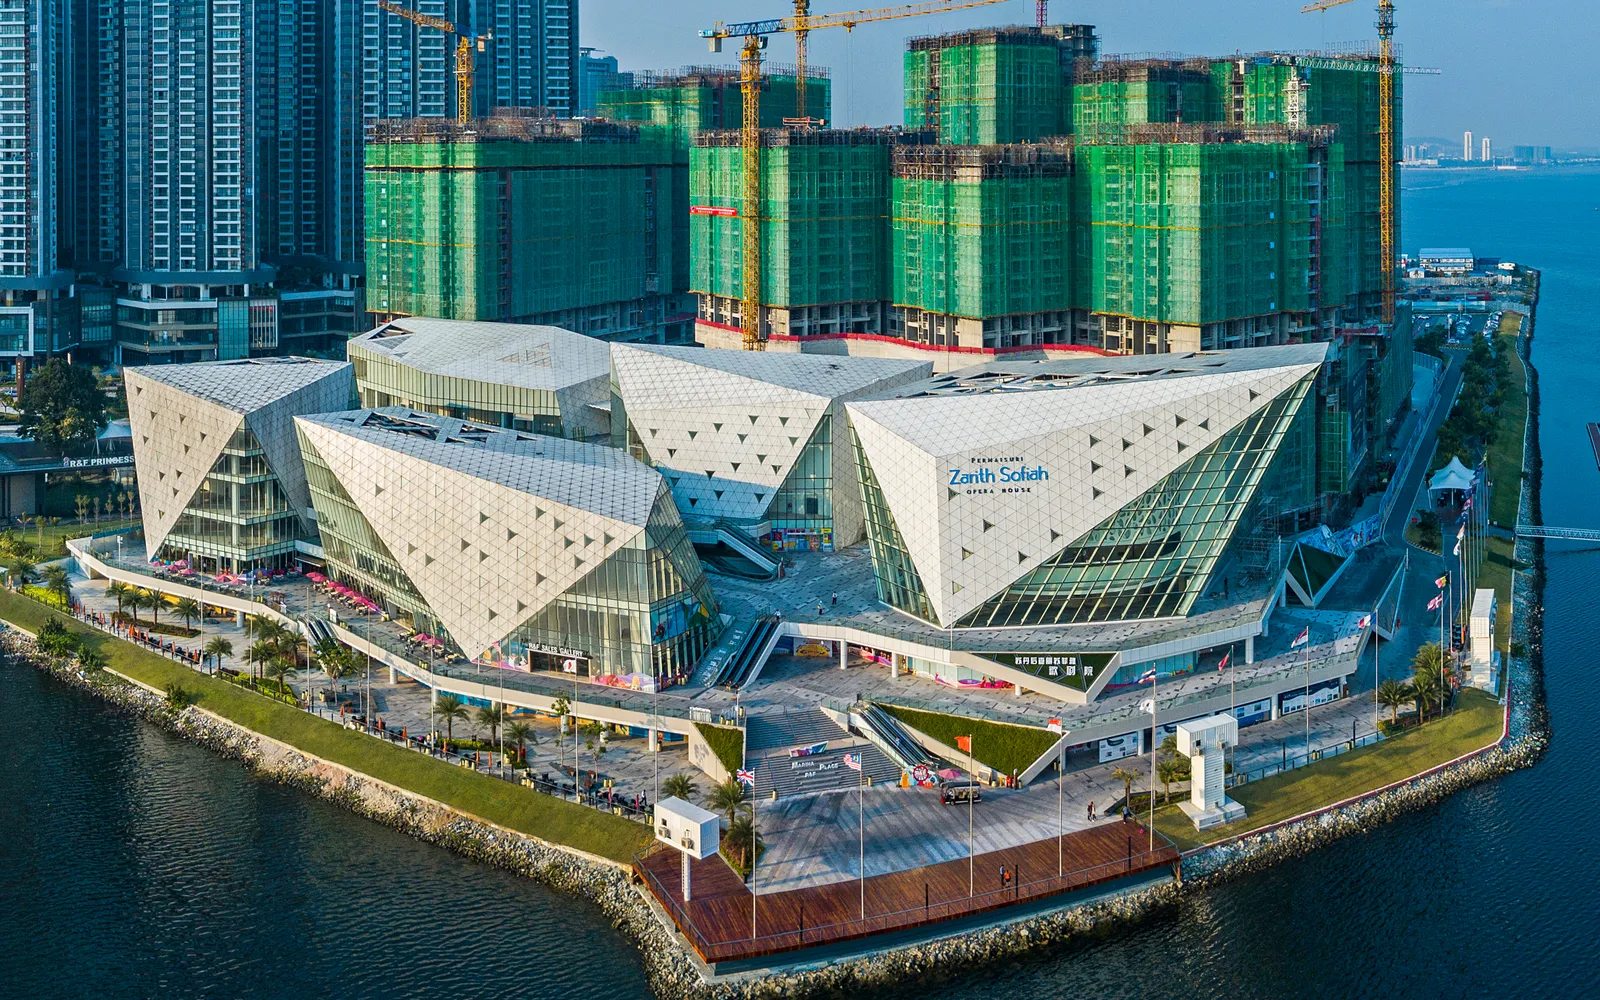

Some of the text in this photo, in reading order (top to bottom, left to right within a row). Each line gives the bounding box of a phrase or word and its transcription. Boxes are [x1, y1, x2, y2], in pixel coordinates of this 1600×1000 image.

[70, 455, 135, 467] R&F PRINCESS
[949, 465, 1049, 485] Zarith Sofiah
[541, 645, 559, 654] SALES
[560, 647, 583, 658] GALLERY
